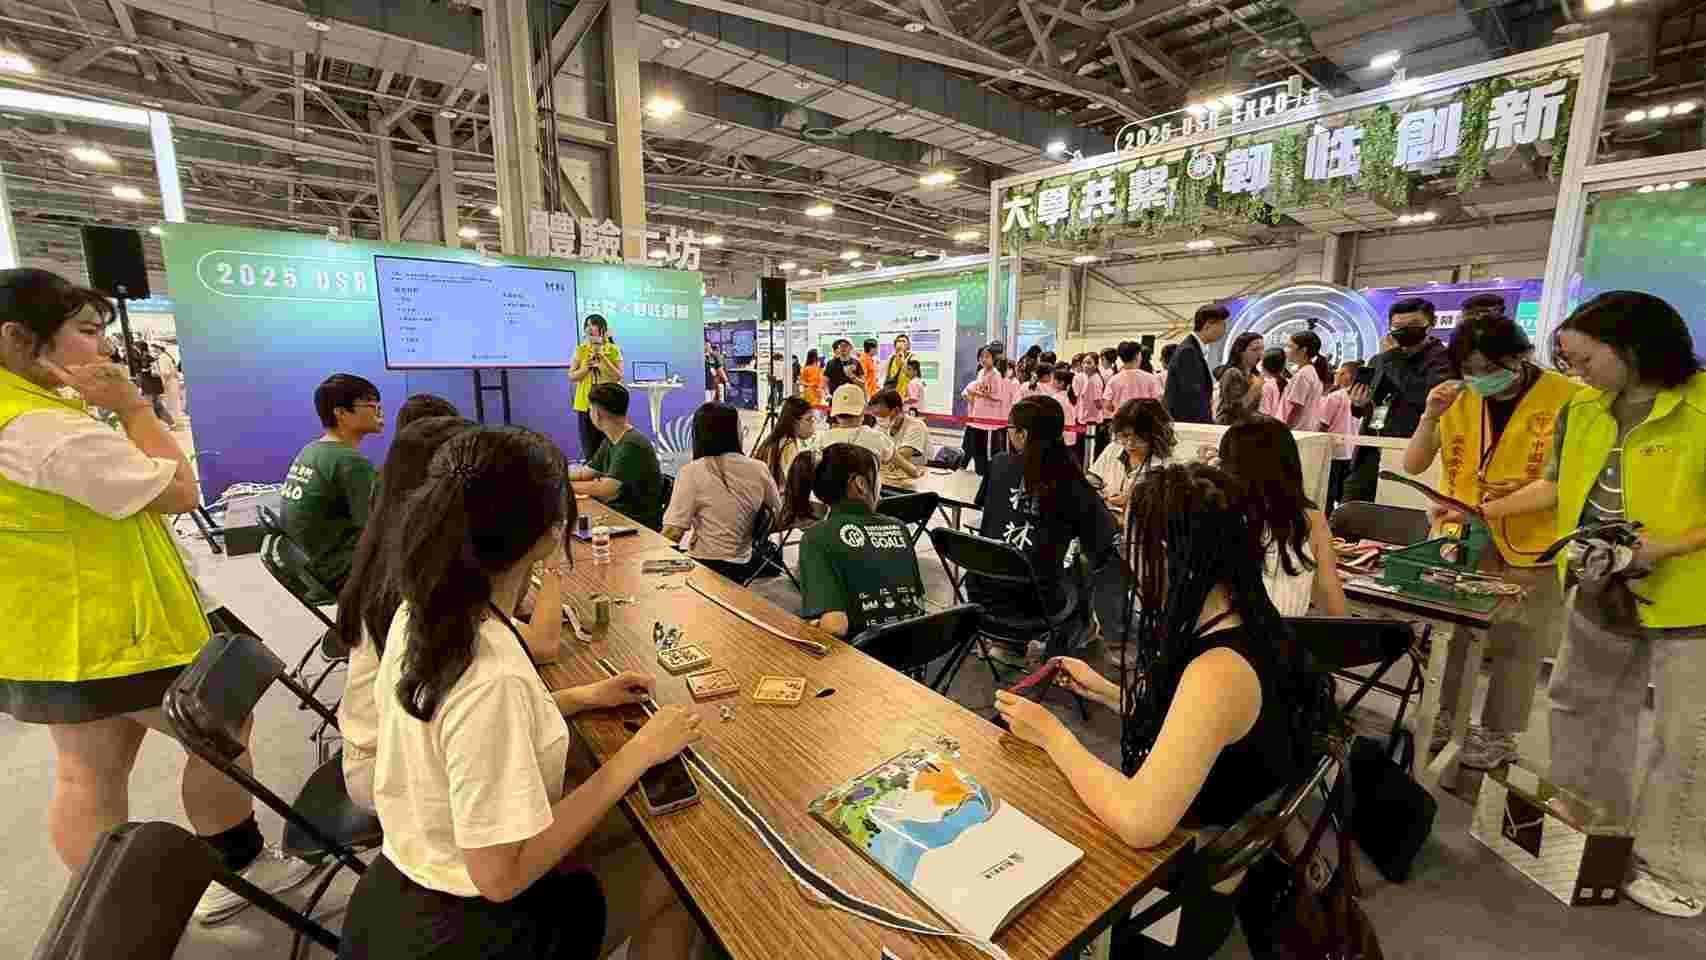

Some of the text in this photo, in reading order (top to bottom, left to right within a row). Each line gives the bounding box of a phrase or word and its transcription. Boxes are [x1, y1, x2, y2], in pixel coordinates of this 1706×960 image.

[1124, 123, 1171, 151] 2025
[1232, 93, 1289, 123] EXPO
[215, 261, 298, 289] 2025
